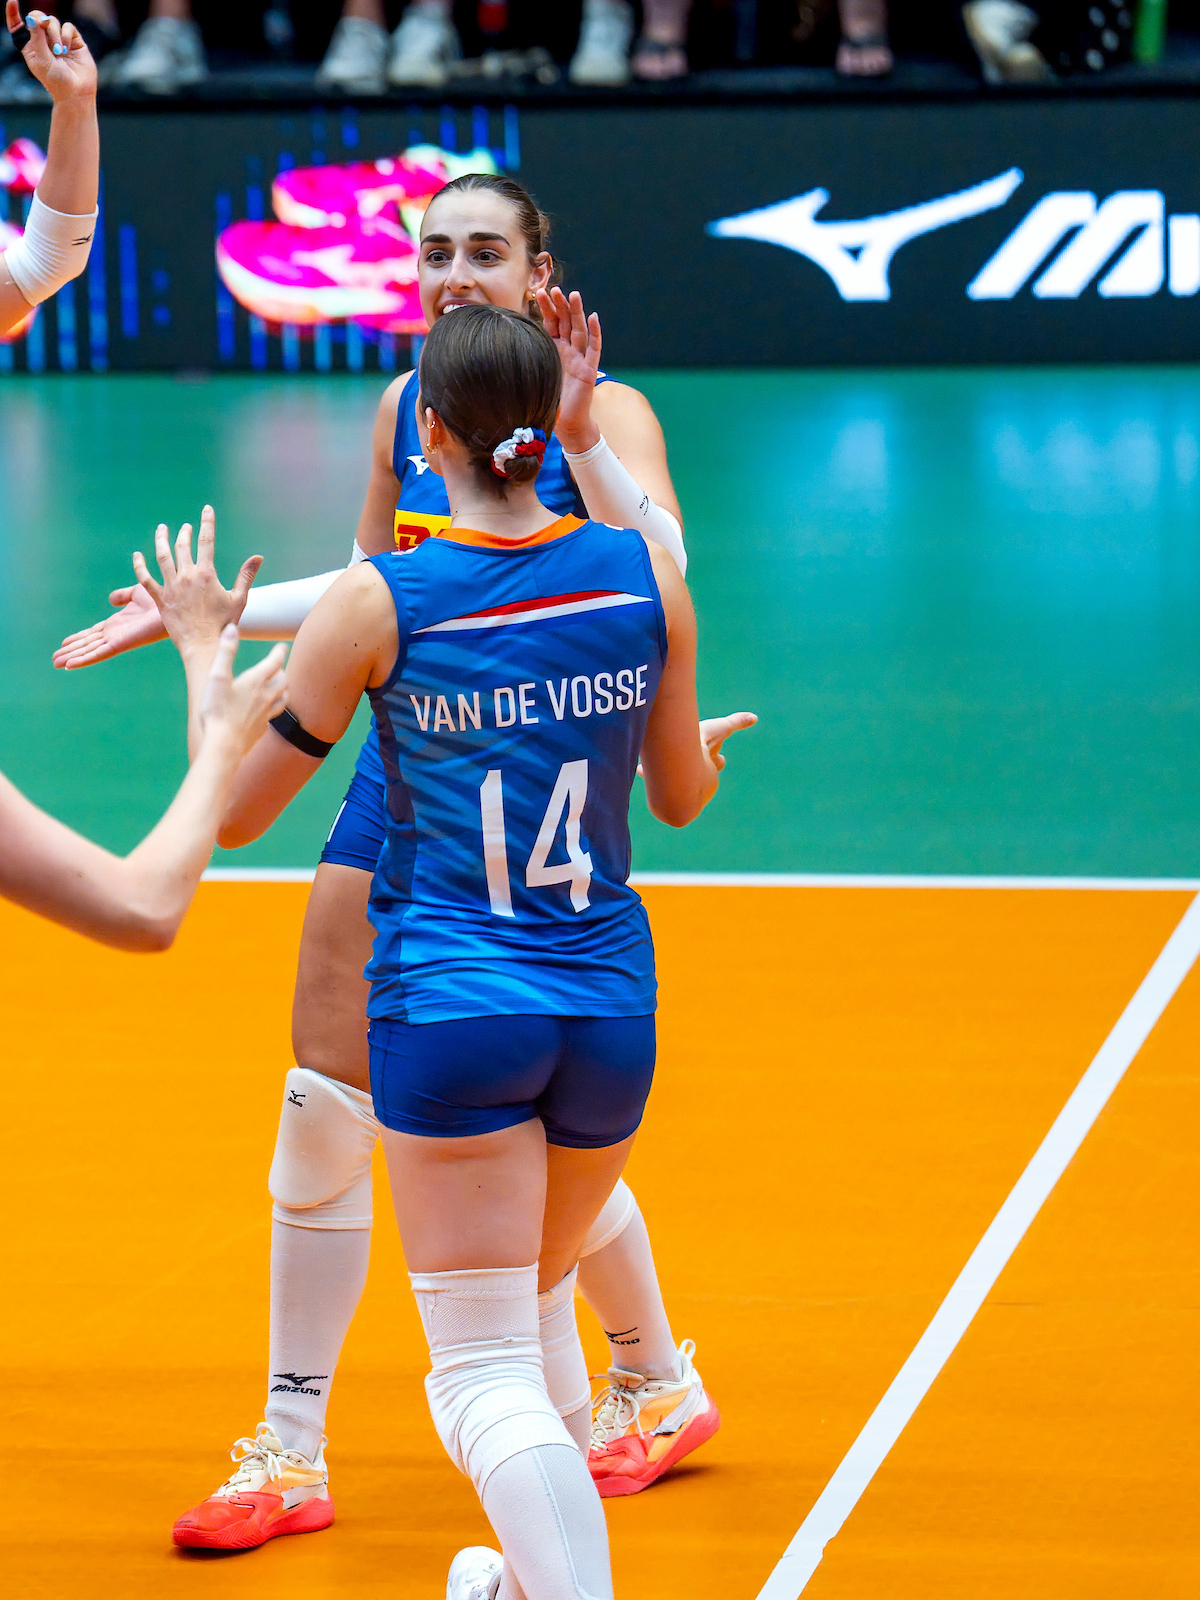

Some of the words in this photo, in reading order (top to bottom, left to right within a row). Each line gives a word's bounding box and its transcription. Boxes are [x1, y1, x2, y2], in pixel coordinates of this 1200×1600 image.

[409, 691, 482, 732] VAN
[494, 682, 539, 728] DE
[546, 665, 648, 721] VOSSE
[480, 759, 593, 917] 14
